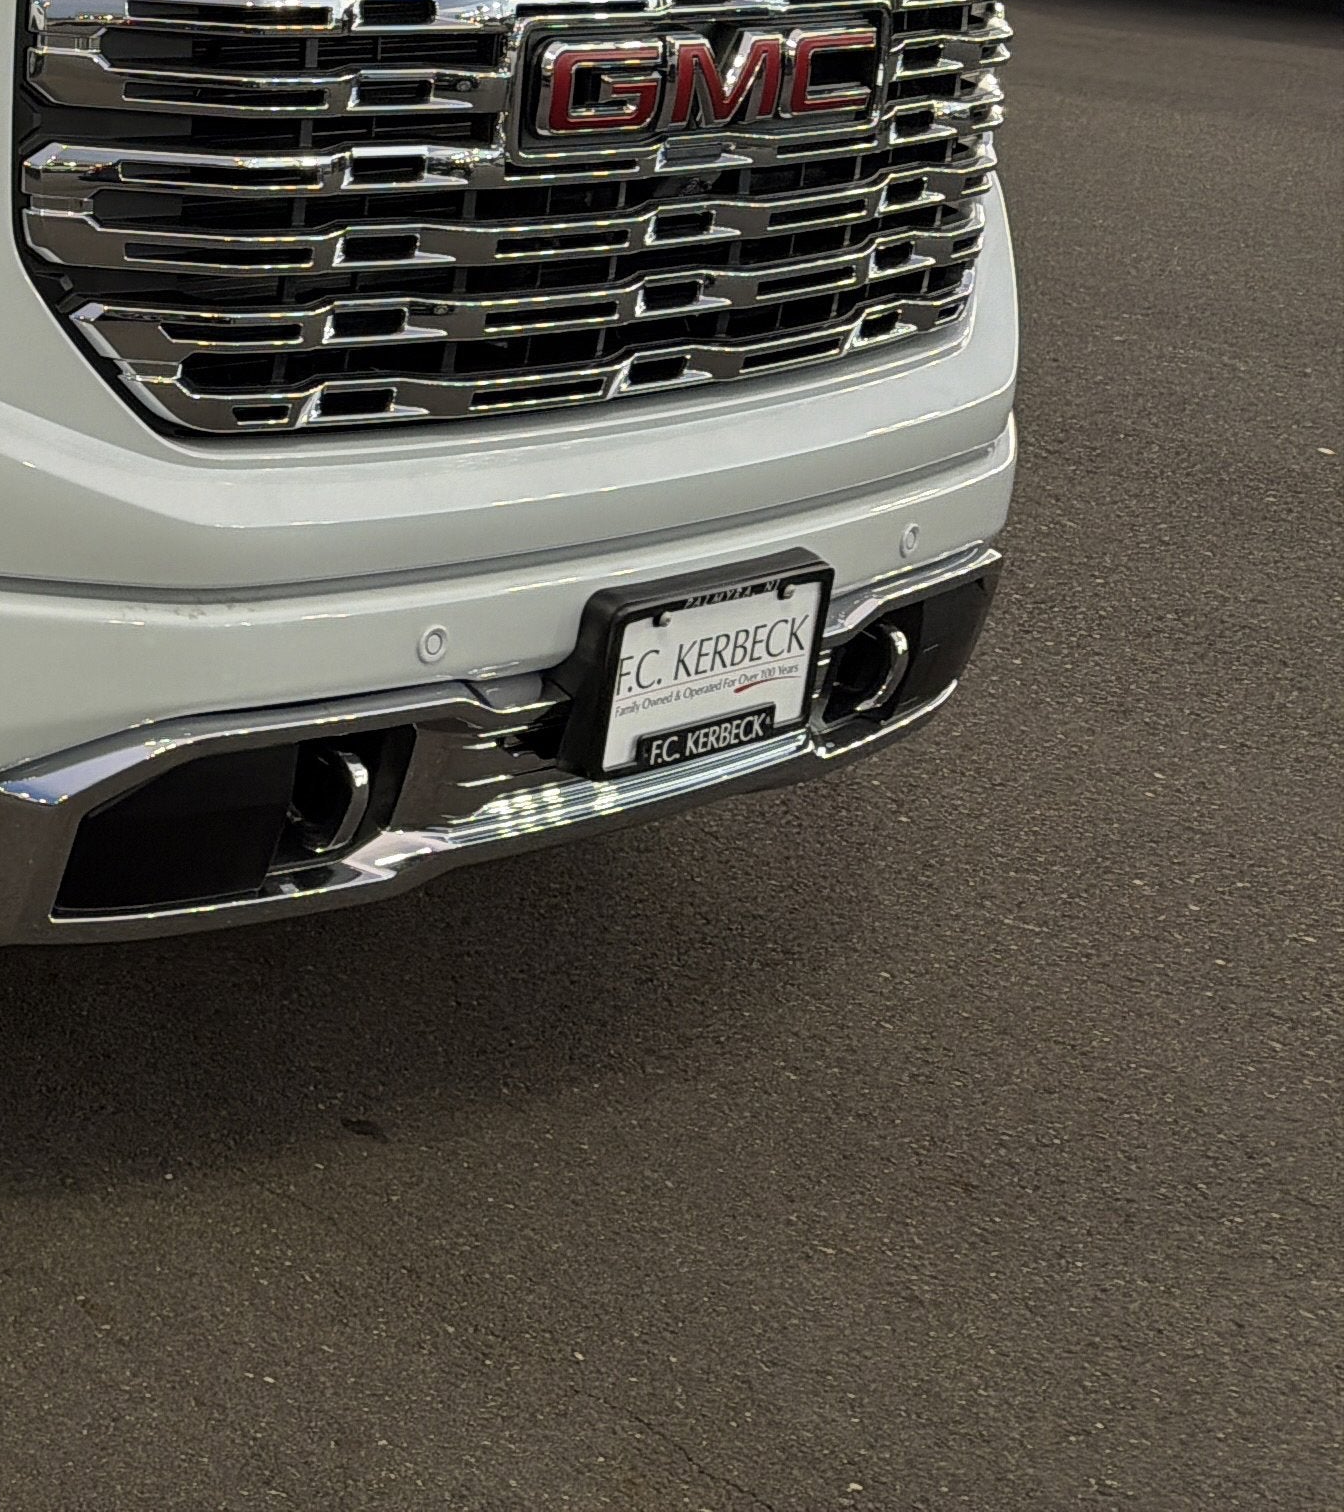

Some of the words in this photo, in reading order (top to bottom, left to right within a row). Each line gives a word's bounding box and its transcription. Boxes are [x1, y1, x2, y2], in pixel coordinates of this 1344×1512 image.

[542, 28, 877, 136] GMC
[616, 649, 662, 696] F.C.
[673, 615, 810, 681] KERBECK
[615, 700, 642, 718] Family
[642, 691, 673, 710] Owned
[683, 679, 722, 700] Operated
[722, 676, 736, 689] For
[738, 672, 759, 685] Over
[778, 664, 799, 676] Years
[650, 736, 681, 765] F.C.
[685, 713, 766, 757] KERBECK
